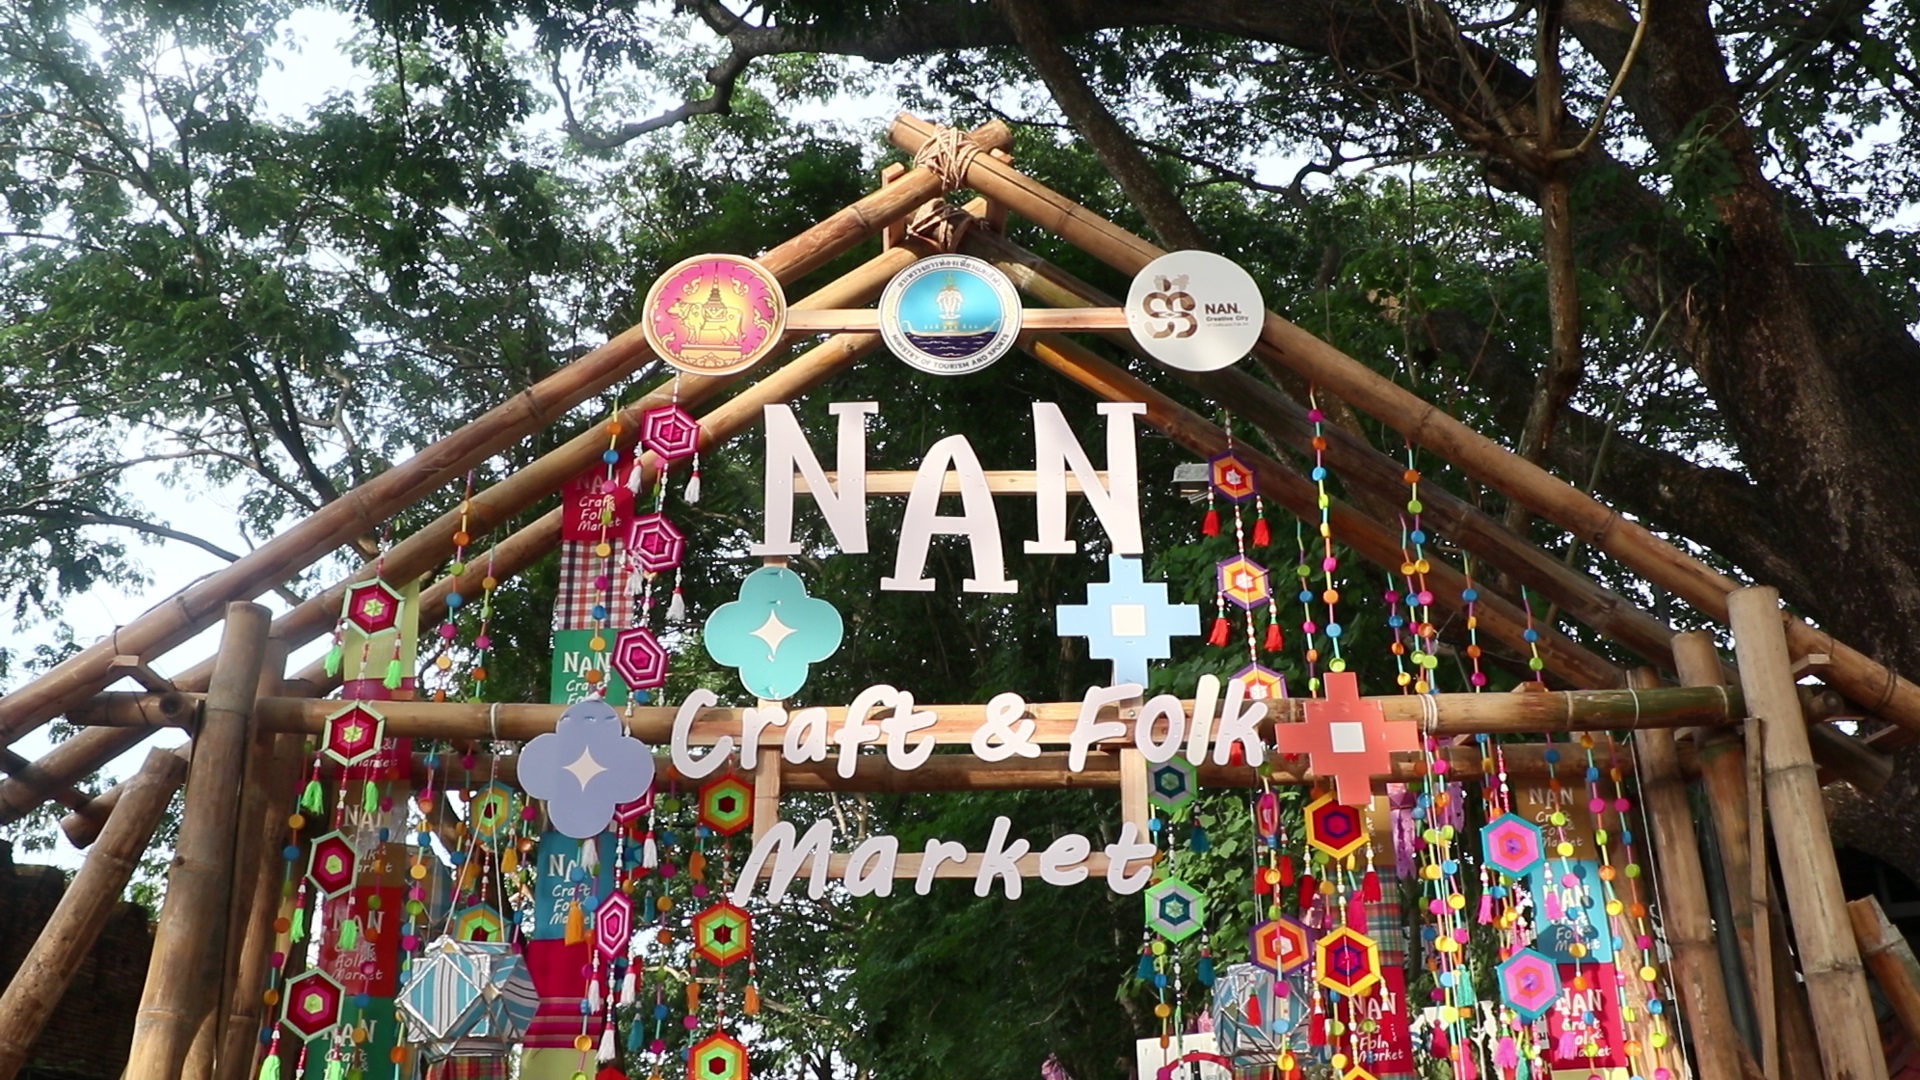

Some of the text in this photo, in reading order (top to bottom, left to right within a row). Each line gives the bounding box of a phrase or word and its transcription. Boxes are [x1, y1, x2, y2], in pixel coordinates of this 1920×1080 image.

[892, 334, 920, 360] MINISTRY
[933, 360, 970, 370] TOURISM
[972, 355, 988, 366] AND
[988, 334, 1009, 356] SPORTS
[580, 508, 603, 520] Fol
[750, 402, 1147, 594] NAN
[670, 673, 1269, 778] Craft & Folk
[731, 815, 1157, 907] Market
